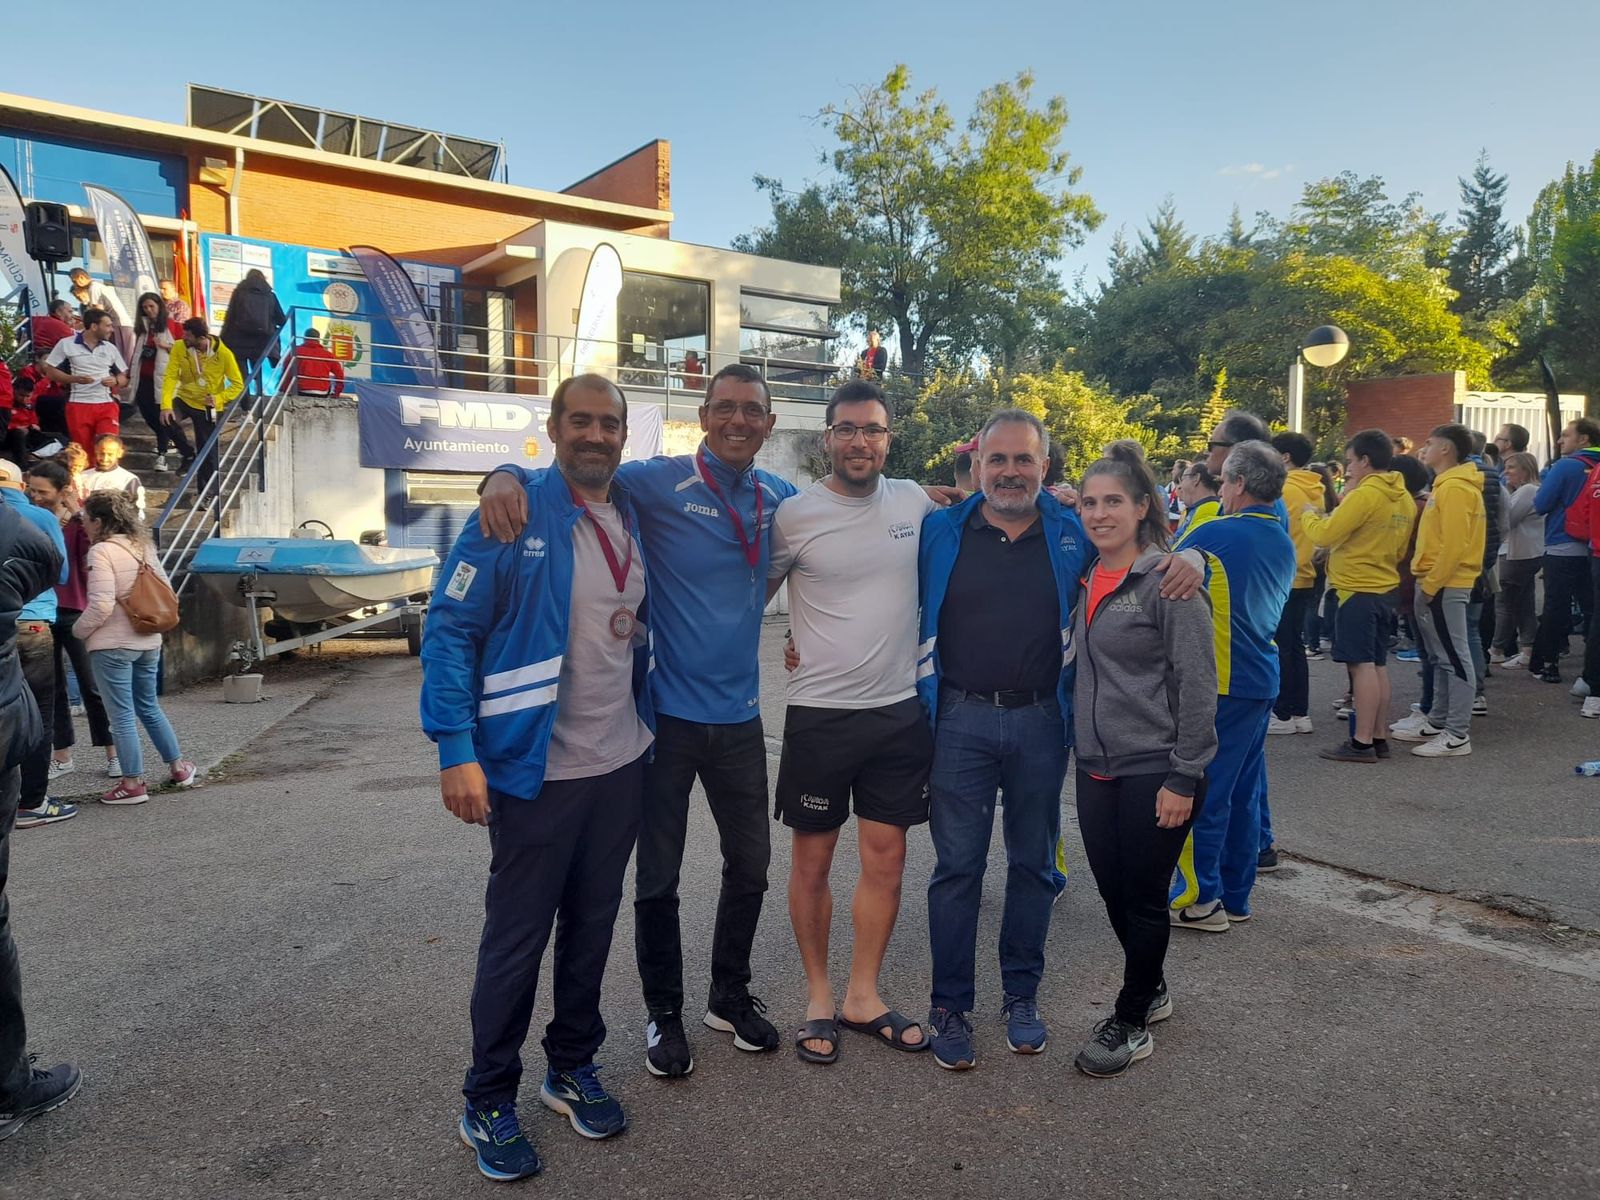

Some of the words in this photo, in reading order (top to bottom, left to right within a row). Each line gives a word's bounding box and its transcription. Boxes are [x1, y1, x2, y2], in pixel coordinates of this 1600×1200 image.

[398, 395, 532, 432] FMD
[404, 437, 509, 453] Ayuntamiento
[1109, 603, 1143, 613] adidas
[803, 802, 828, 810] KAYAK
